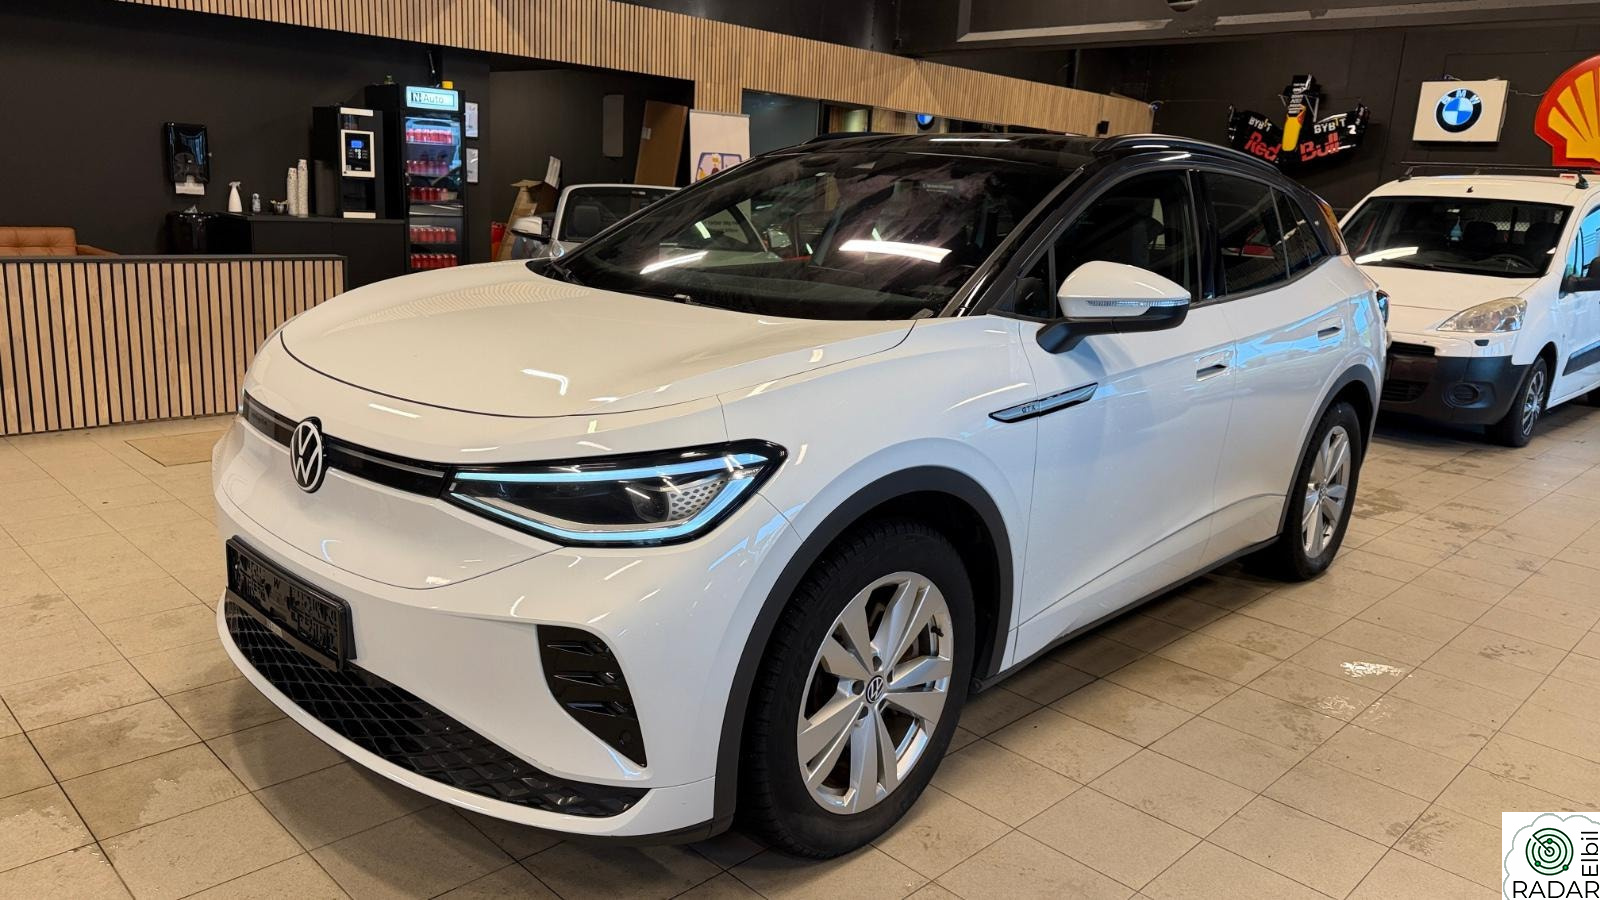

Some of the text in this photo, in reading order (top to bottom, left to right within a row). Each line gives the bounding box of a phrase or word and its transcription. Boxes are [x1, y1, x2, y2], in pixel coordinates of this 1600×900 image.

[424, 94, 444, 104] Auto
[1440, 89, 1480, 105] BMW
[1244, 131, 1339, 161] Red Bull
[1022, 405, 1036, 413] GTX
